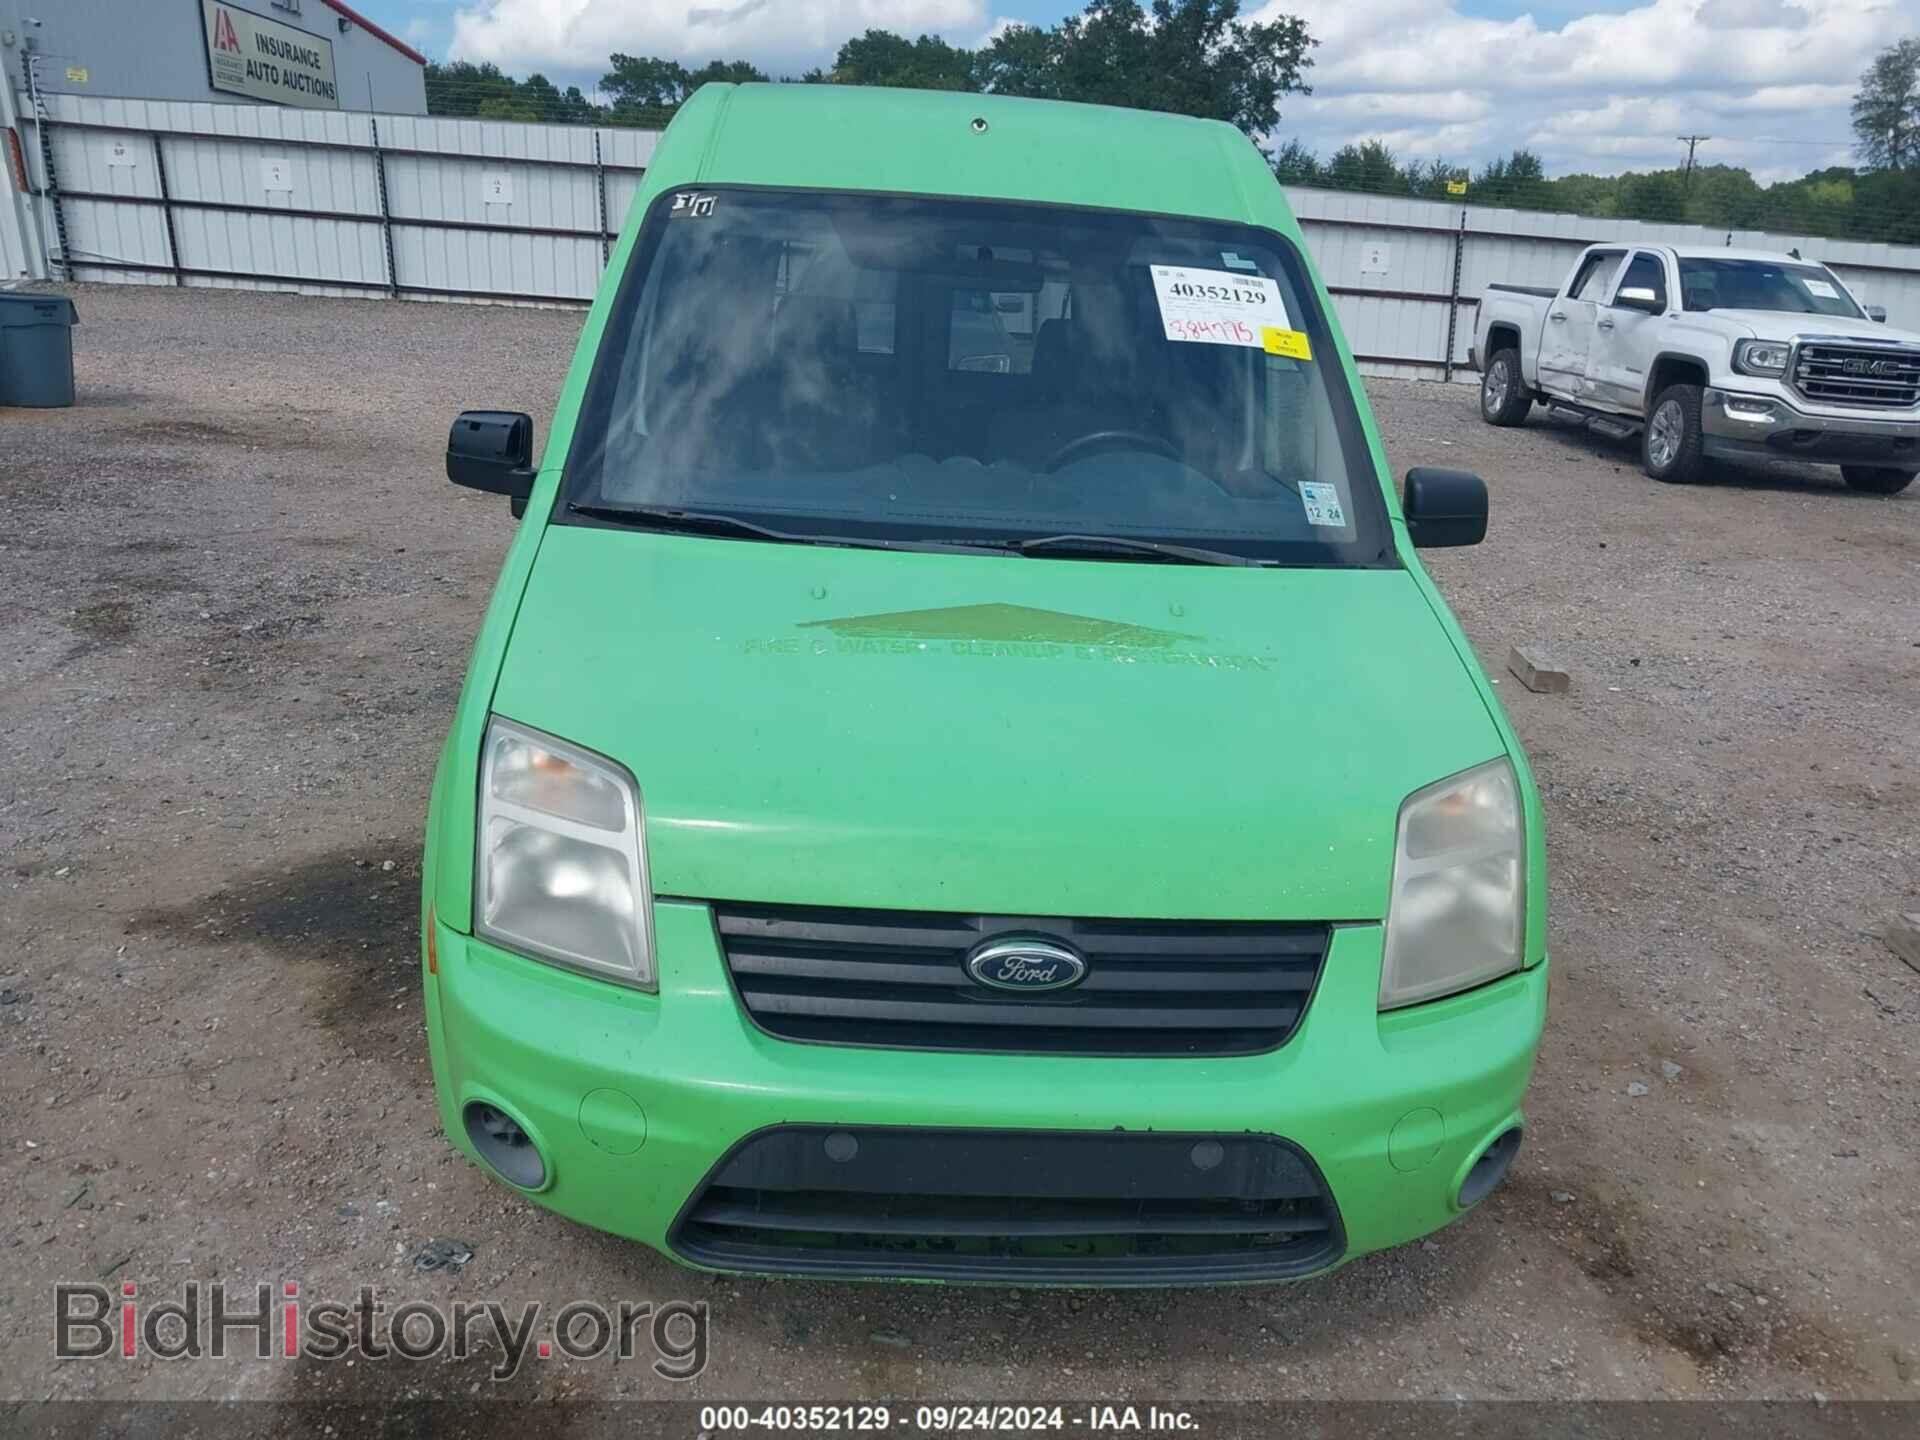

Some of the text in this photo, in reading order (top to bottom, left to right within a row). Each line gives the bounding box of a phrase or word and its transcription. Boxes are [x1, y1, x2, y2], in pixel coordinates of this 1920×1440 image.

[255, 31, 321, 70] INSURANCE
[246, 59, 279, 85] AUTO
[282, 68, 336, 101] AUCTIONS
[1170, 282, 1266, 305] 40352129
[1843, 358, 1899, 376] GMC
[1327, 508, 1341, 519] 24
[998, 956, 1058, 982] Ford
